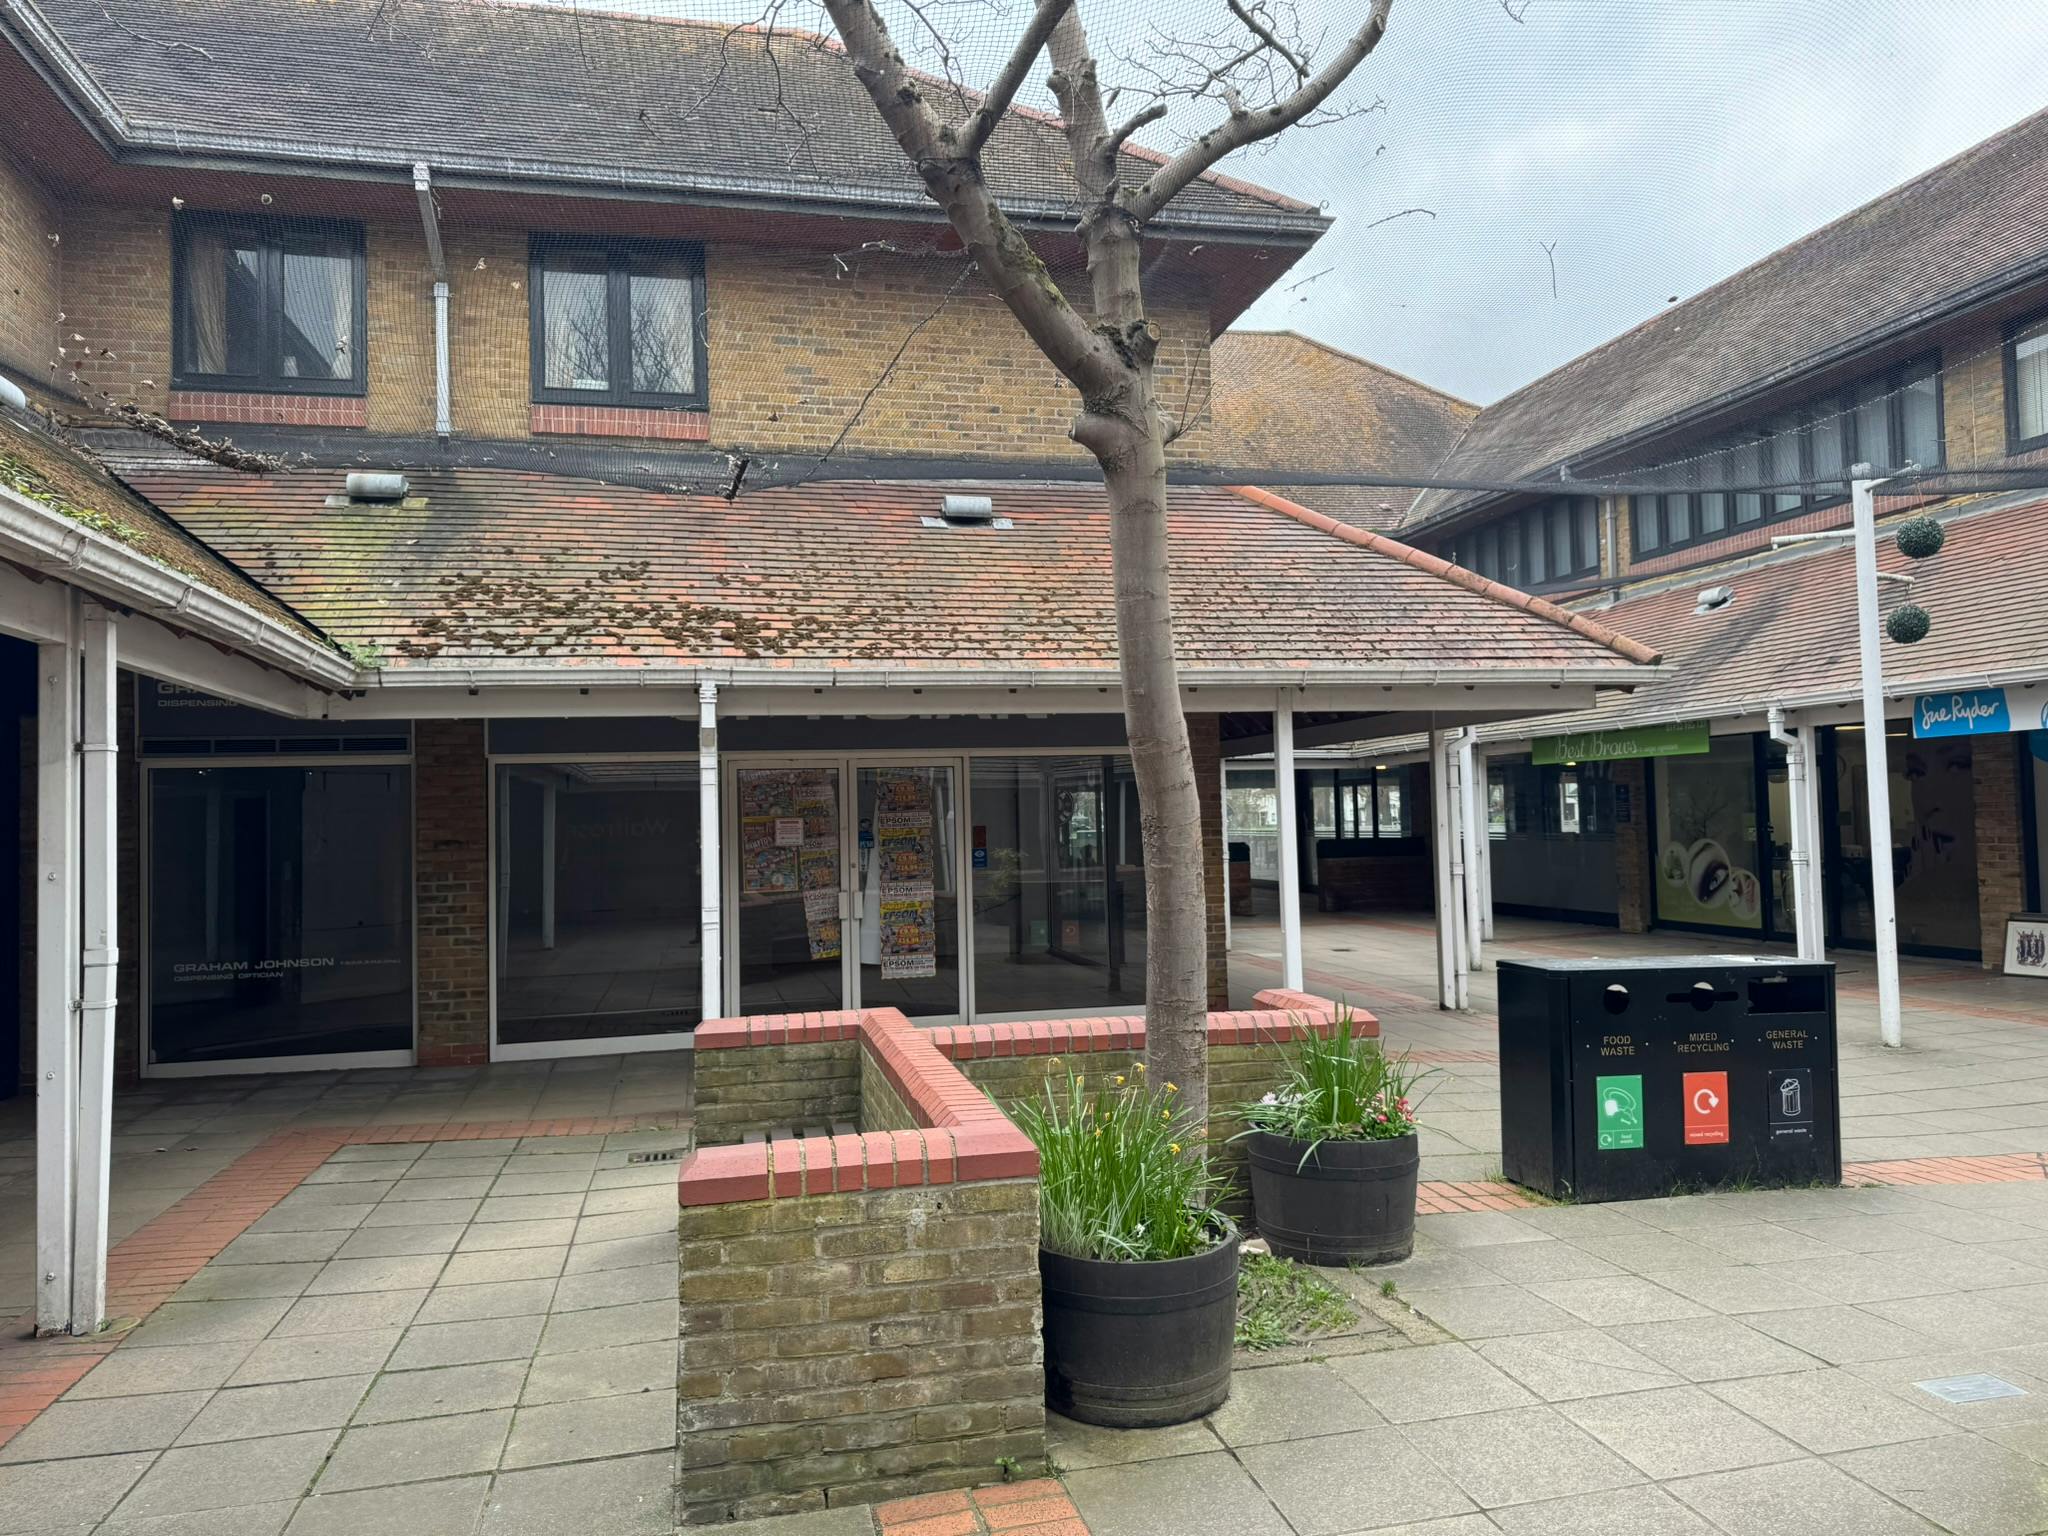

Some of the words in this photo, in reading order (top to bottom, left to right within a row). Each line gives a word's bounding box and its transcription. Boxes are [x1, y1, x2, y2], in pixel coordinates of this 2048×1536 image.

[1922, 696, 1951, 730] Sue
[1951, 695, 1999, 729] Ryder
[1557, 735, 1585, 760] Best
[173, 961, 249, 973] GRAHAM
[254, 957, 335, 970] JOHNSON
[883, 960, 914, 968] EPSOM
[173, 972, 235, 982] DISPENSING
[238, 971, 284, 979] OPTICIAN
[1603, 1035, 1631, 1045] FOOD
[1689, 1033, 1718, 1042] MIXED
[1765, 1030, 1809, 1040] GENERAL
[1677, 1042, 1730, 1053] RECYCLING
[1772, 1040, 1804, 1049] WASTE
[1600, 1046, 1636, 1056] WASTE
